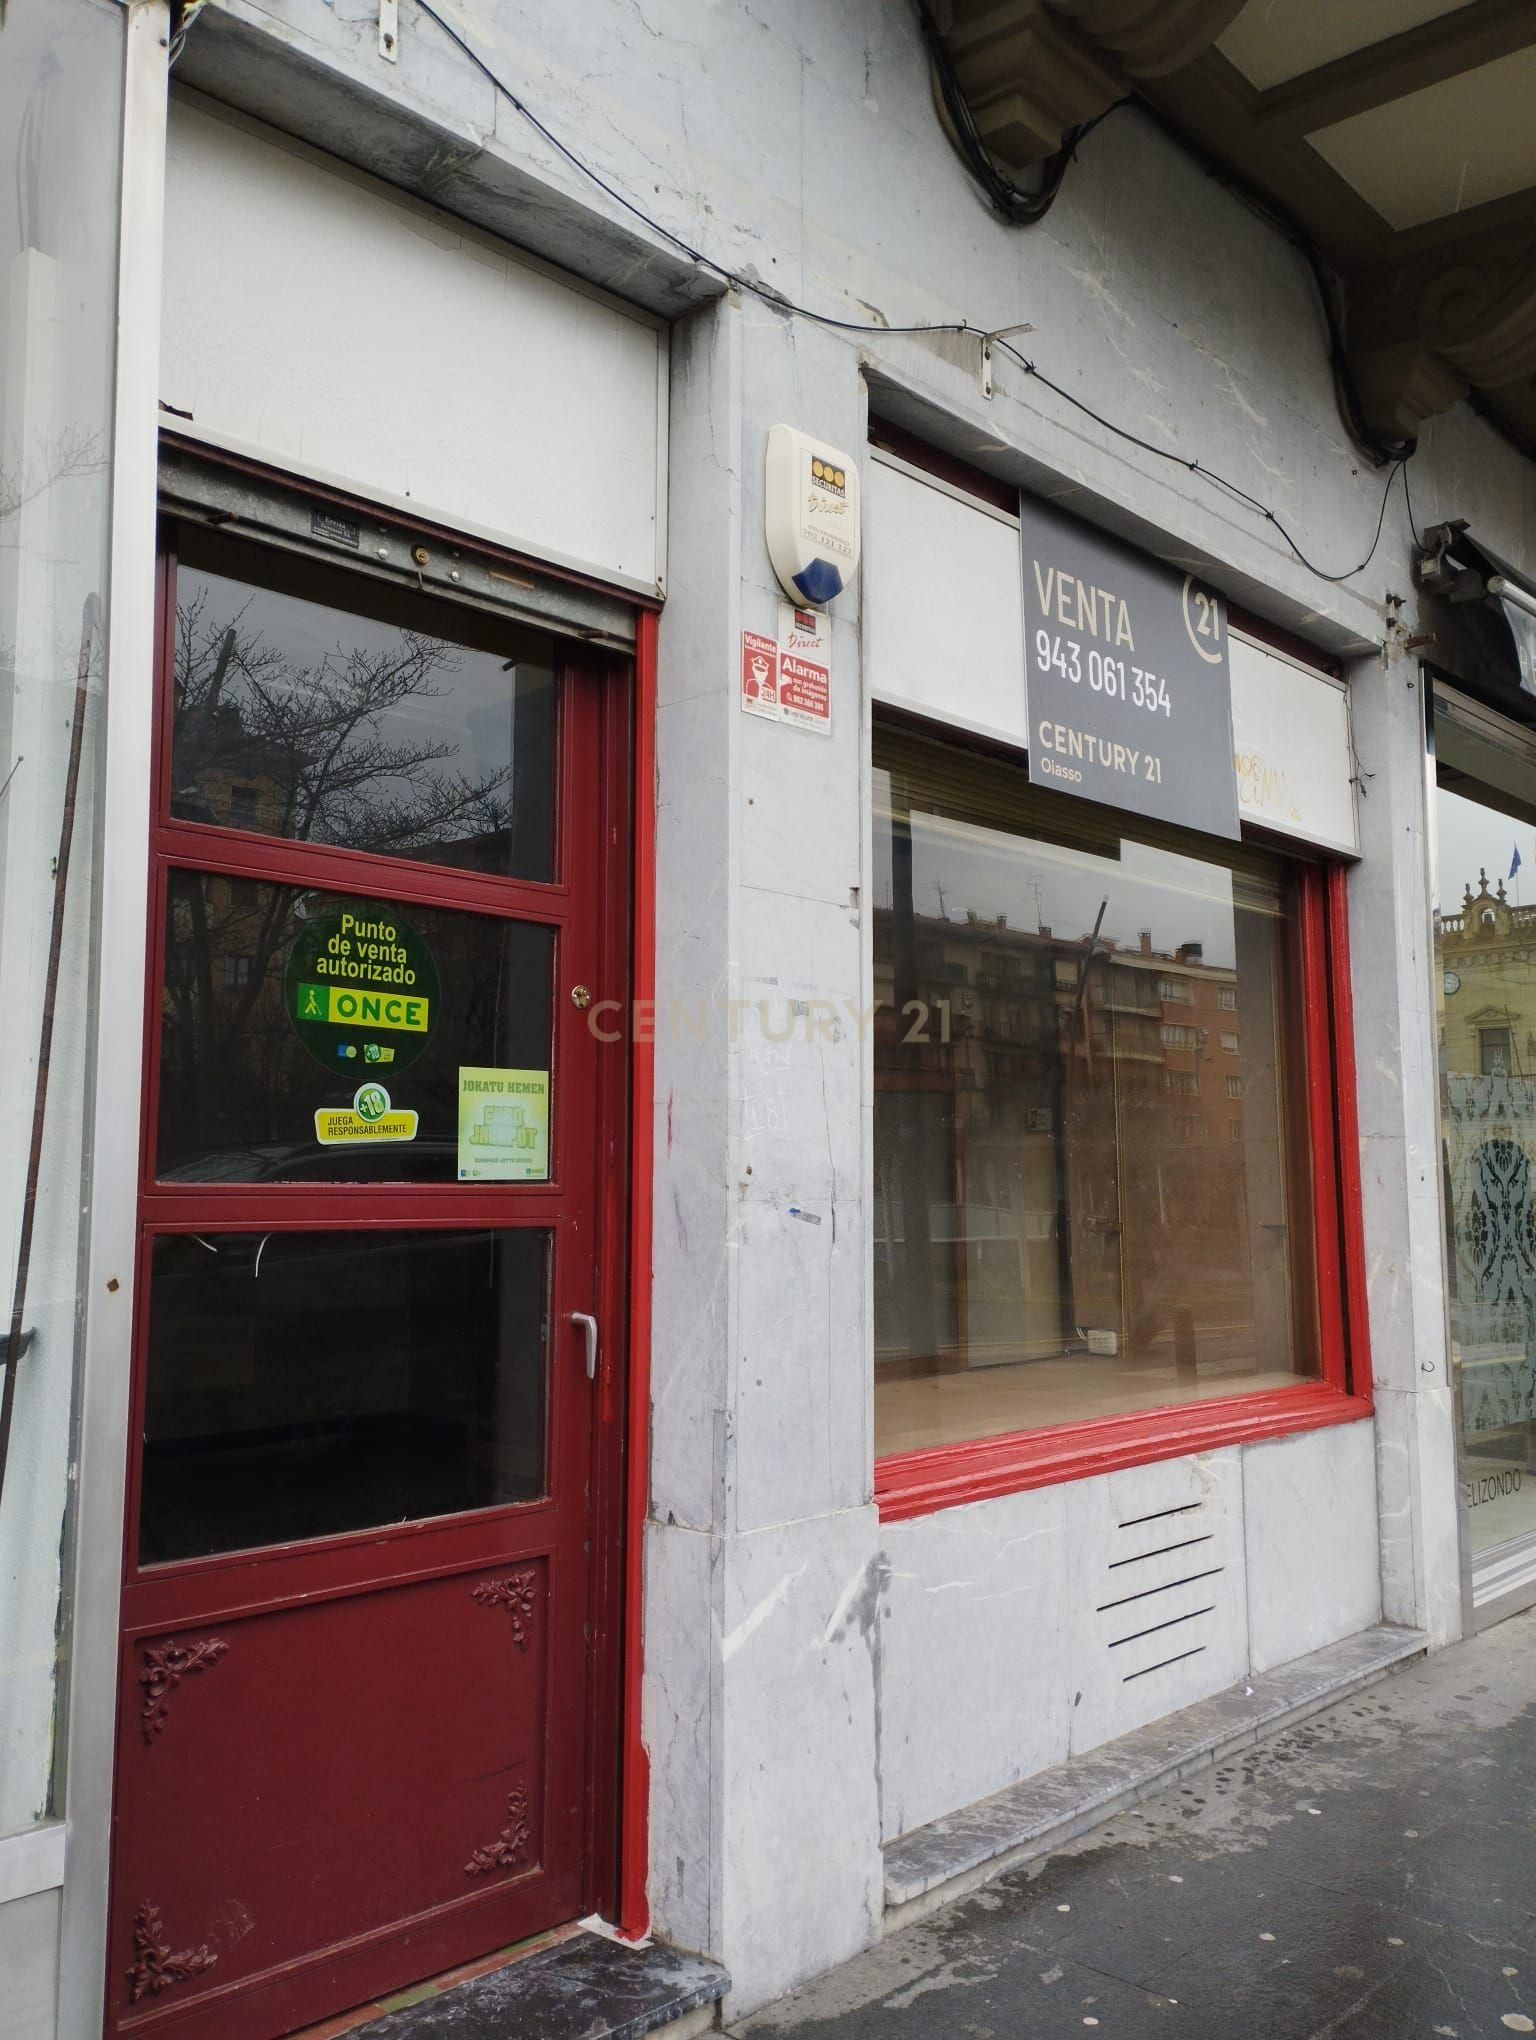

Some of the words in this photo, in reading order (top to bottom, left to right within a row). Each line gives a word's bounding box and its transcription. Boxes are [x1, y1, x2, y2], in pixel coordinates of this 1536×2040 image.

[1034, 560, 1135, 652] VENTA
[744, 633, 777, 654] Vigilante
[782, 657, 828, 685] Alarma
[1036, 629, 1082, 684] 943
[1088, 650, 1126, 701] 061
[1131, 666, 1172, 718] 354
[761, 686, 777, 700] 24H
[1039, 720, 1139, 776] CENTURY
[1145, 755, 1162, 784] 21
[1041, 757, 1082, 783] Oiasso
[341, 914, 396, 941] Punto
[328, 934, 351, 956] de
[357, 942, 407, 964] venta
[317, 955, 416, 985] autorizado
[336, 994, 422, 1026] ONCE
[463, 1080, 504, 1093] JOKATU
[508, 1081, 545, 1095] HEMEN
[360, 1091, 384, 1116] +18
[328, 1116, 353, 1126] JUEGA
[328, 1124, 407, 1136] RESPONSABLEMENTE
